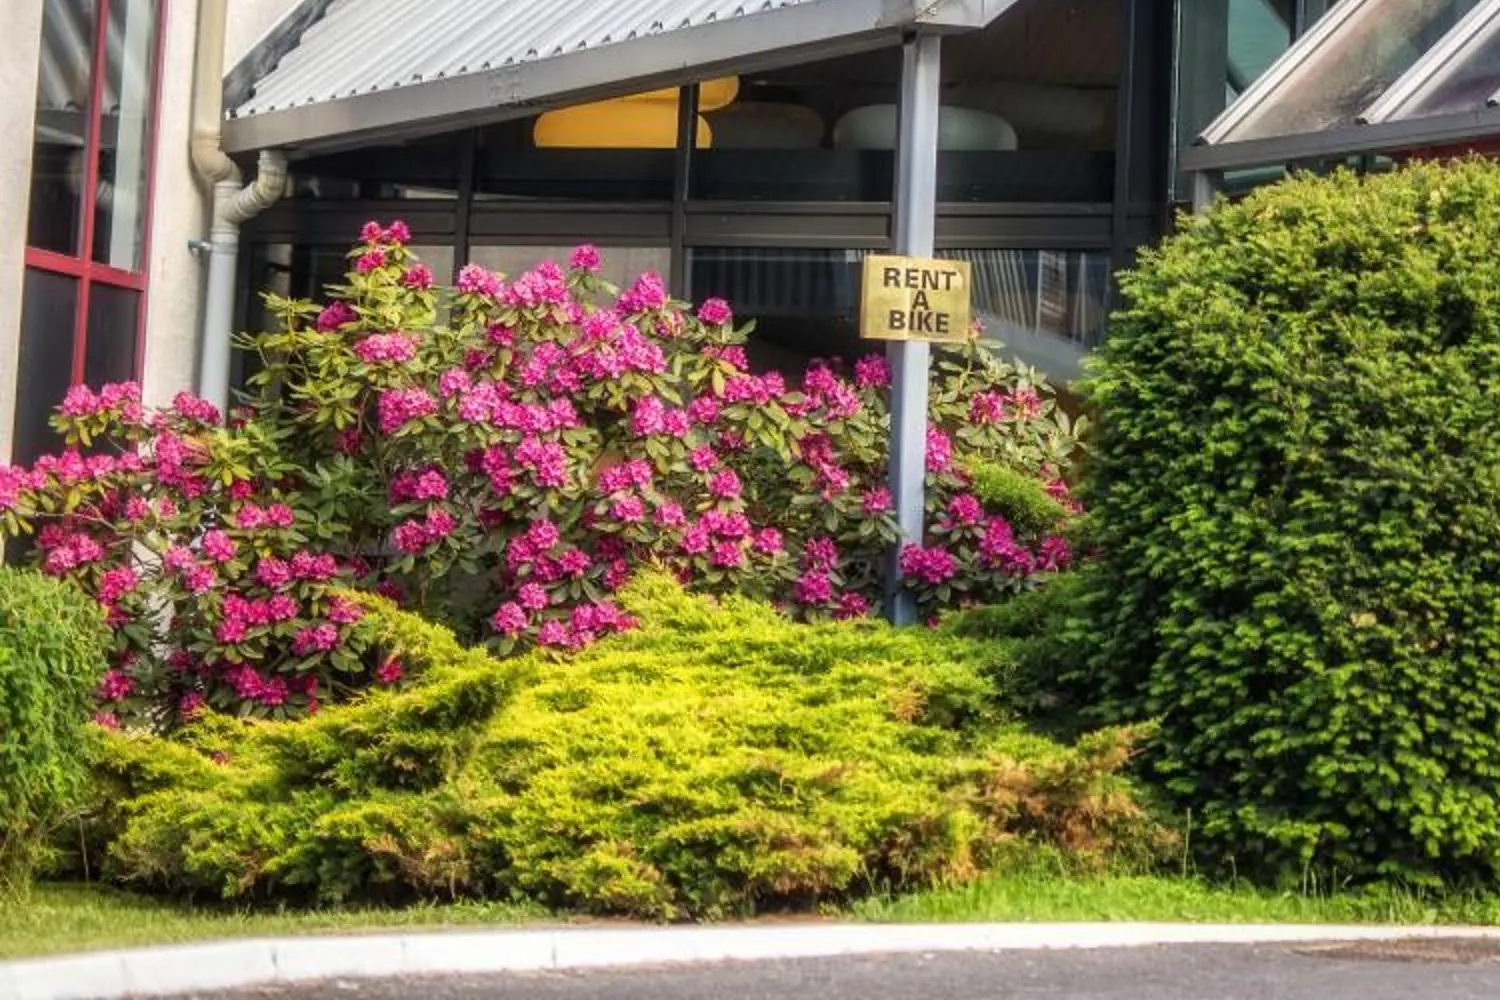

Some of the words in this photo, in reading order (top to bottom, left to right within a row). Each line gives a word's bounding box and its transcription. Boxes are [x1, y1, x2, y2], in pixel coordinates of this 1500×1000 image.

[883, 267, 957, 291] RENT
[911, 289, 930, 311] A
[888, 309, 950, 334] BIKE
